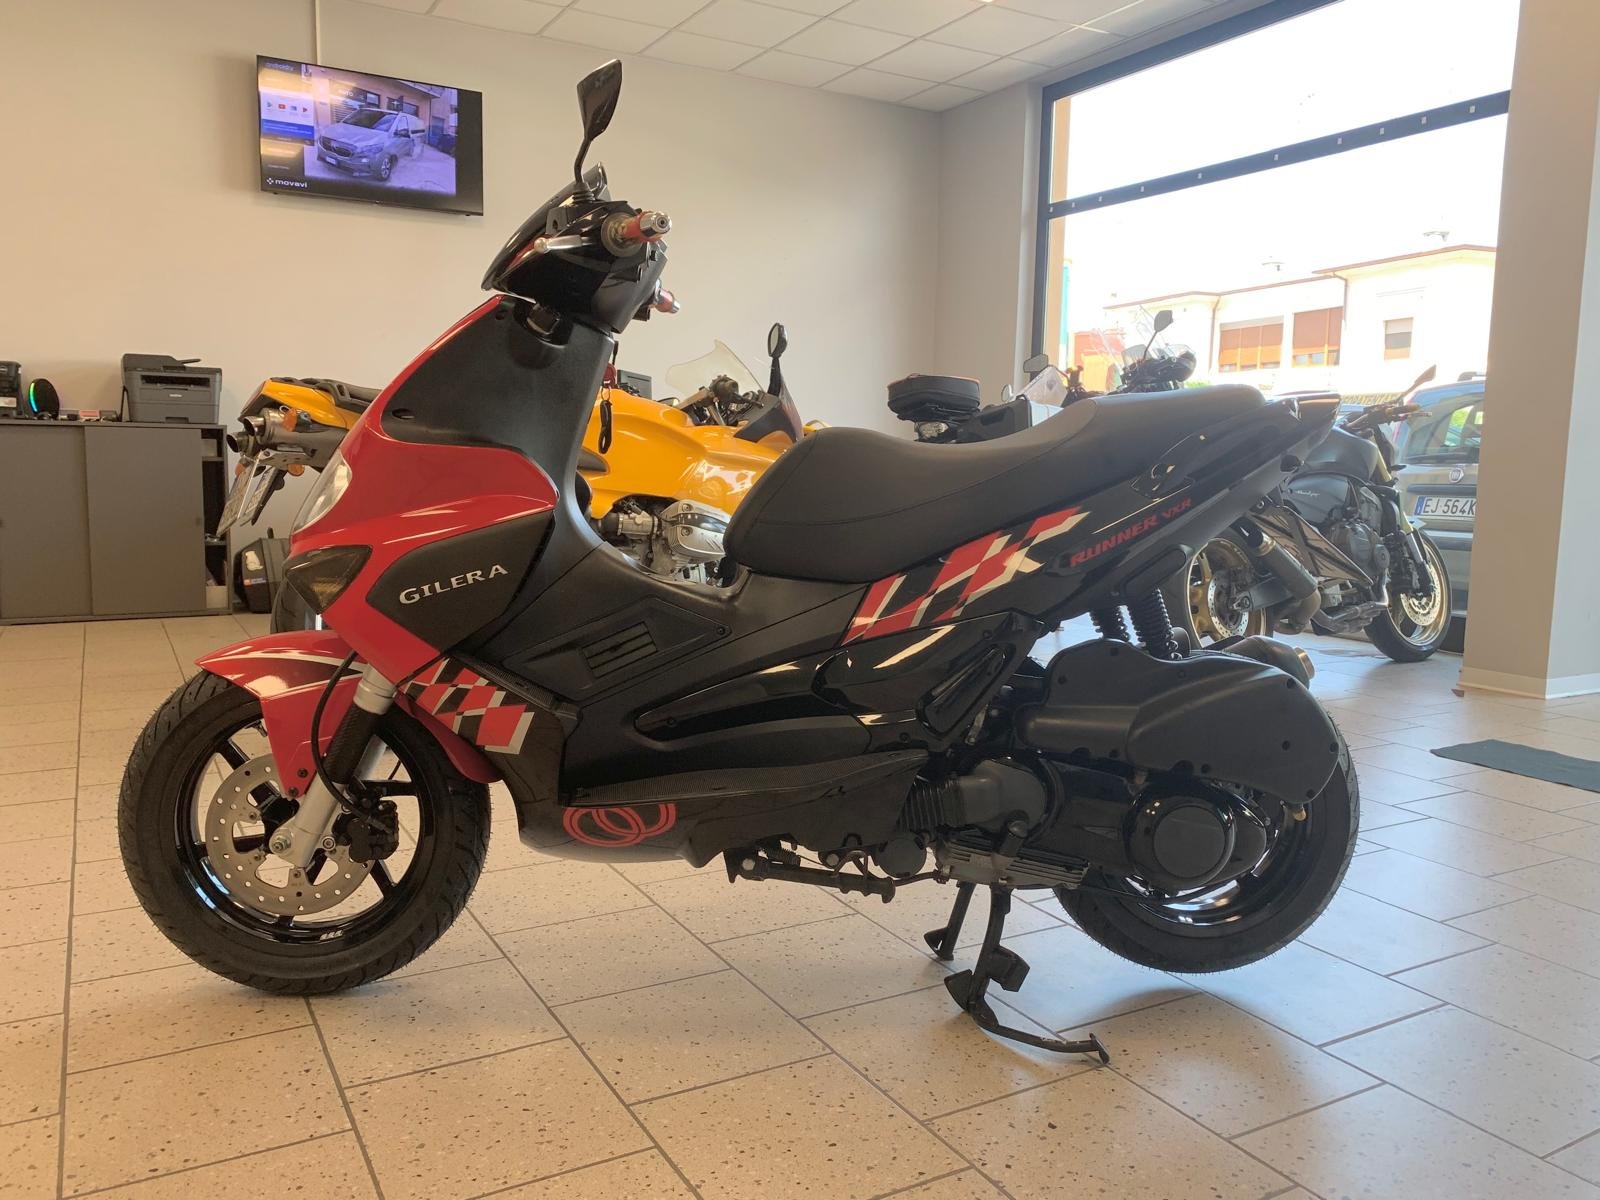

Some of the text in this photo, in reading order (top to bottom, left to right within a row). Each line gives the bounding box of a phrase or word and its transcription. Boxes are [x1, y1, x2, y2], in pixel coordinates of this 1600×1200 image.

[275, 179, 308, 188] movavi
[1422, 498, 1477, 516] EJ 564K
[1070, 514, 1160, 568] RUNNER
[399, 564, 508, 605] GILERA
